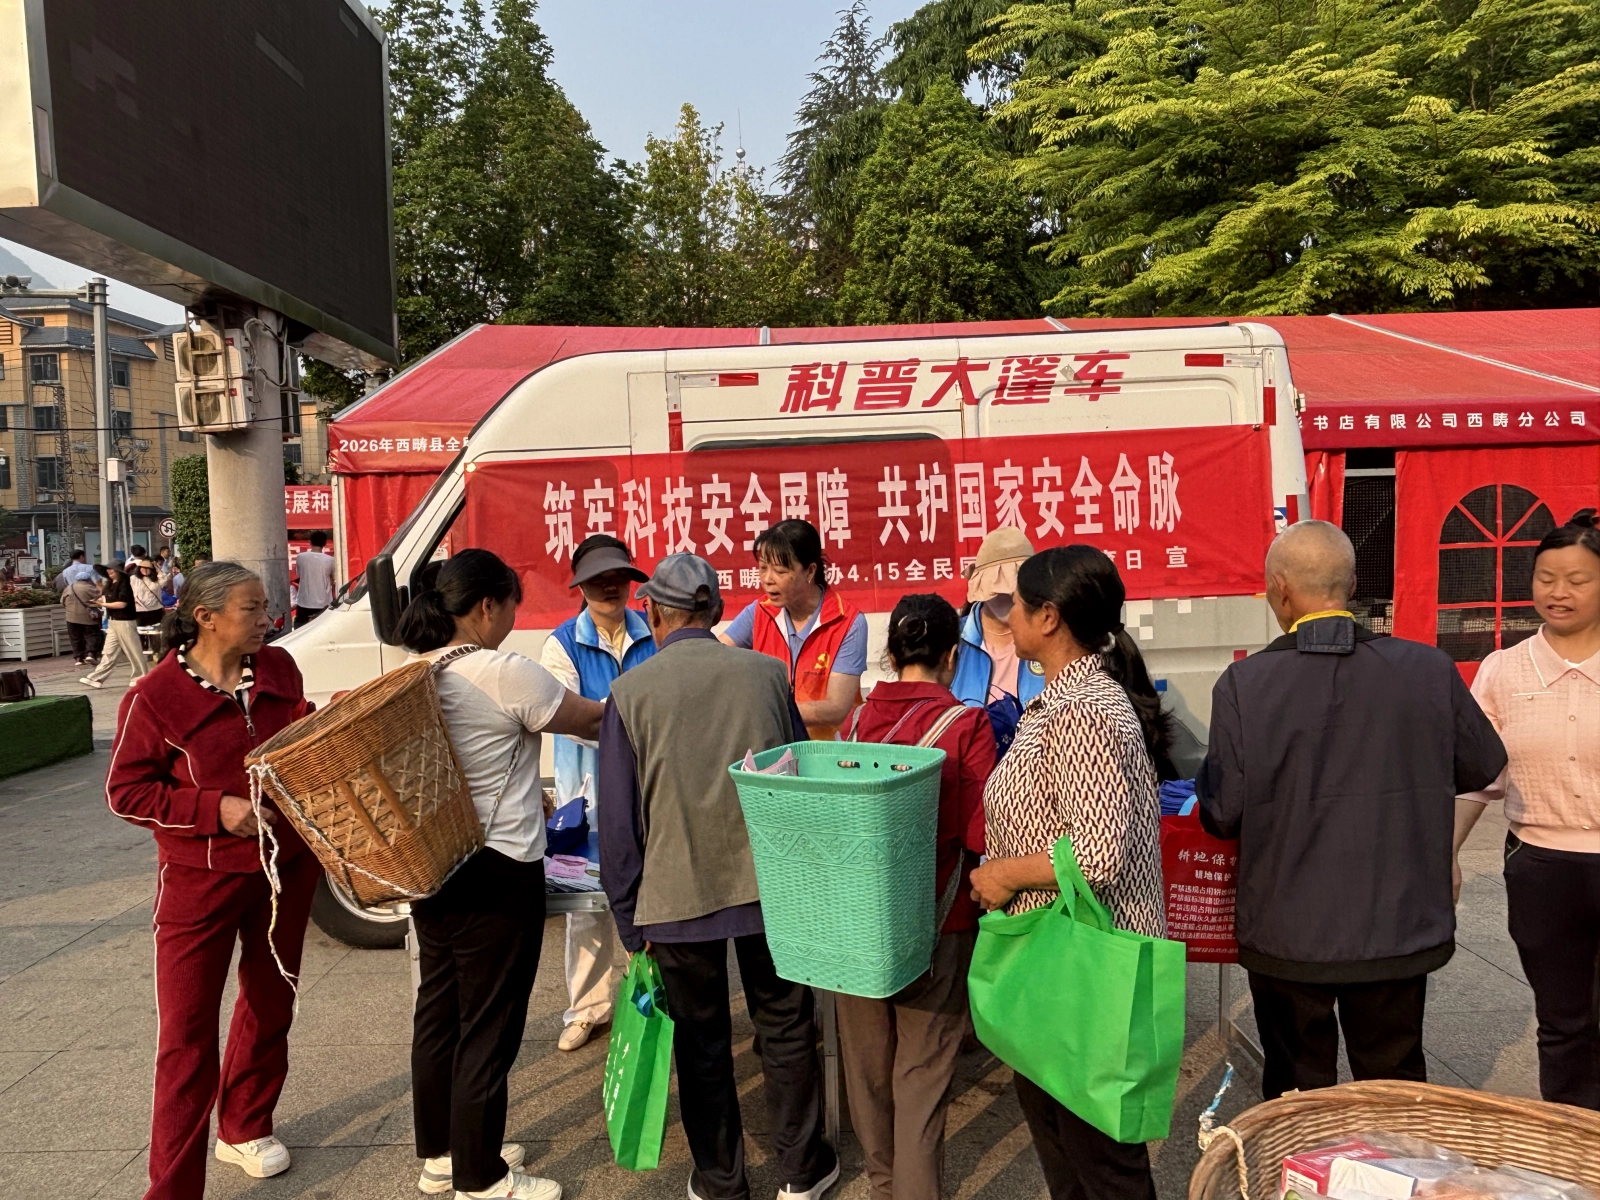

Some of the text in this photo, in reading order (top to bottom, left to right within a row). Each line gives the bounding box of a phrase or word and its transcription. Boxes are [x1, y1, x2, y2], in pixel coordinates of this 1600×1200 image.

[780, 350, 1131, 413] 科普大篷车
[1298, 411, 1586, 431] 书店有限公司西畴分公司
[543, 451, 1182, 564] 筑牢科技安全屏障 共护国家安全命脉
